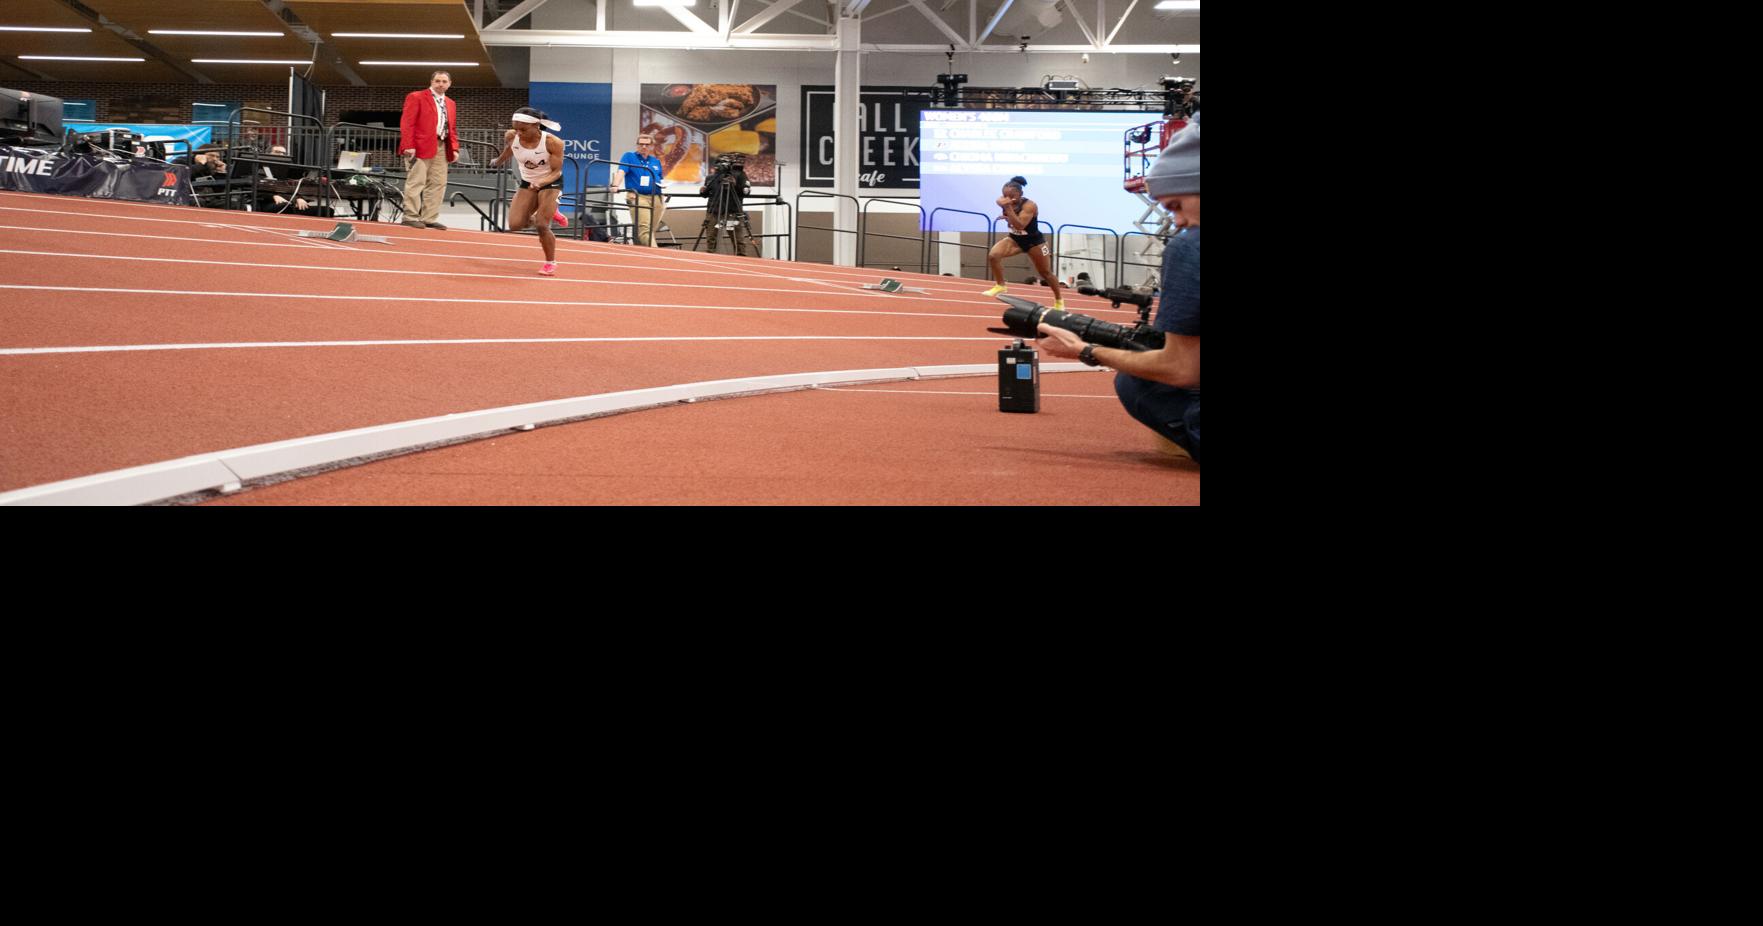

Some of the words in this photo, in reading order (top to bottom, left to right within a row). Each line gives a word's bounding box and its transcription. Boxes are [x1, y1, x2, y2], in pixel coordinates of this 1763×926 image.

[563, 140, 600, 152] PNC
[819, 136, 919, 166] CEEK
[858, 170, 885, 186] afe
[157, 187, 177, 197] PTT
